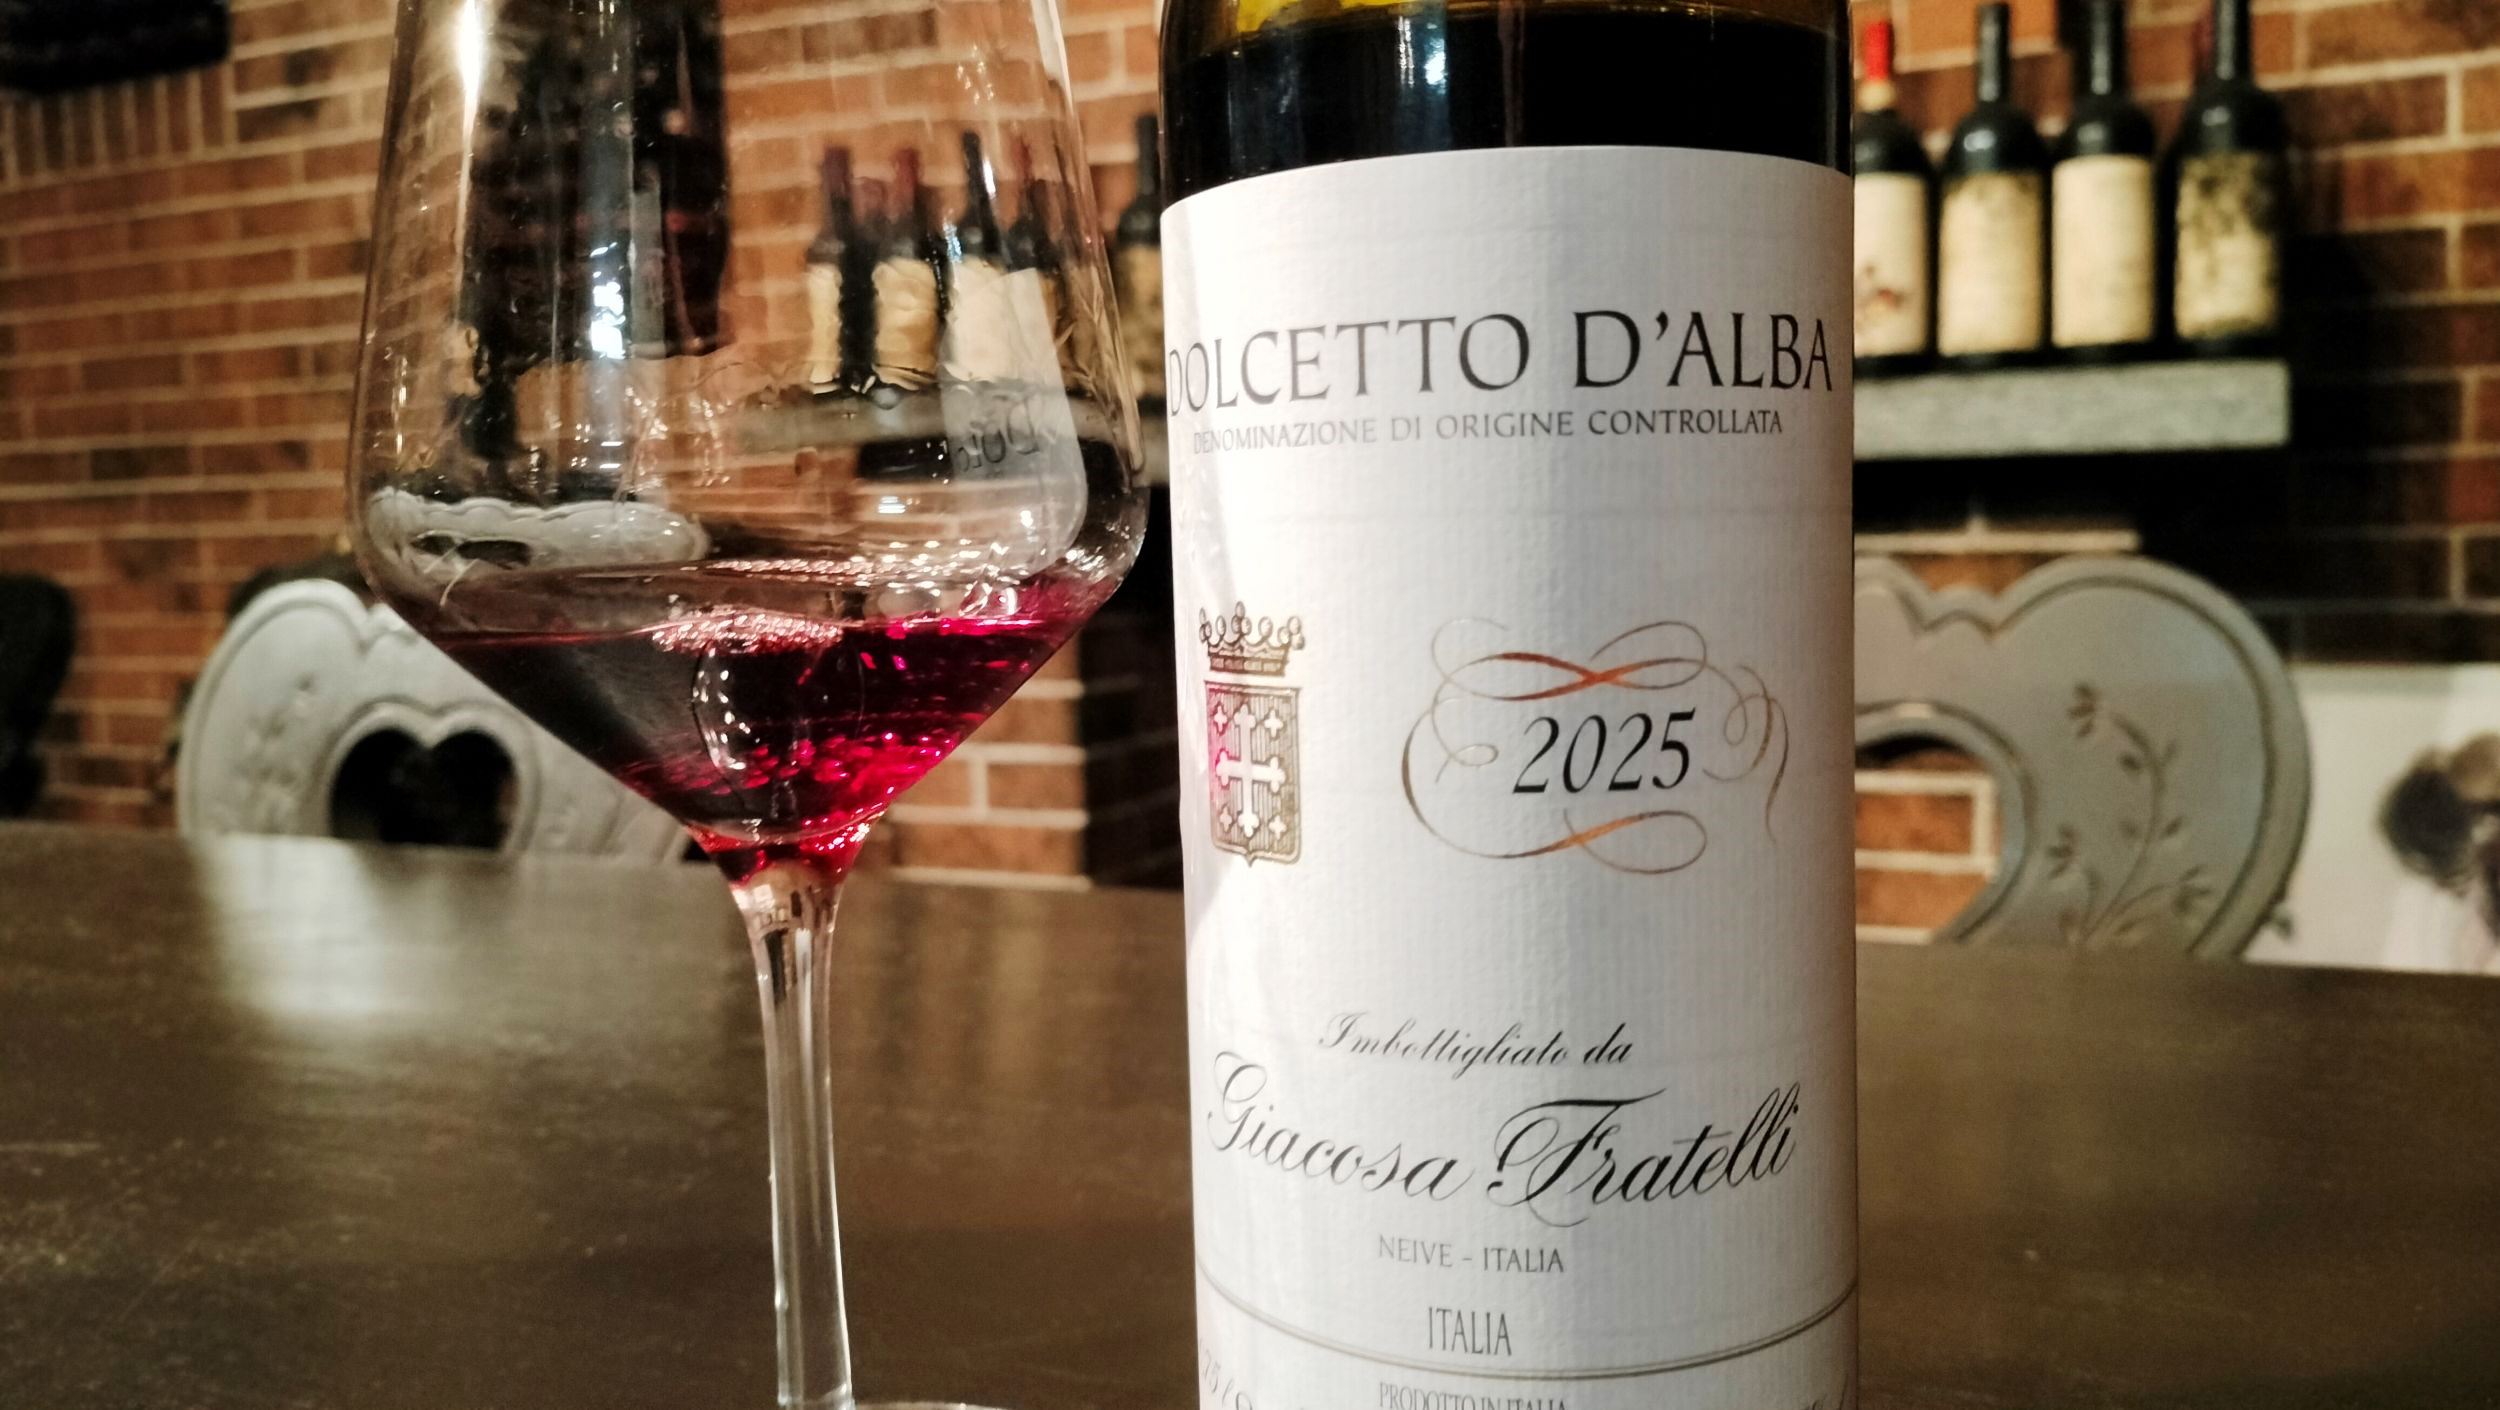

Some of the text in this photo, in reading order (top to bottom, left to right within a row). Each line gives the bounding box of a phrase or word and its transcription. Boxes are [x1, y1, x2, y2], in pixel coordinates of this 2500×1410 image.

[1168, 310, 1833, 417] DOLCETTO D'ALBA
[1194, 408, 1783, 454] DENOMINAZIONE DI ORIGINE CONTROLLATA
[1512, 707, 1696, 795] 2025
[1318, 1012, 1633, 1079] Imbottigliato da
[1206, 1051, 1801, 1227] Giacosa Fratelli
[1378, 1235, 1453, 1268] NEIVE
[1484, 1247, 1564, 1273] ITALIA
[1428, 1307, 1512, 1356] ITALIA
[1379, 1382, 1476, 1410] PRODOTTO
